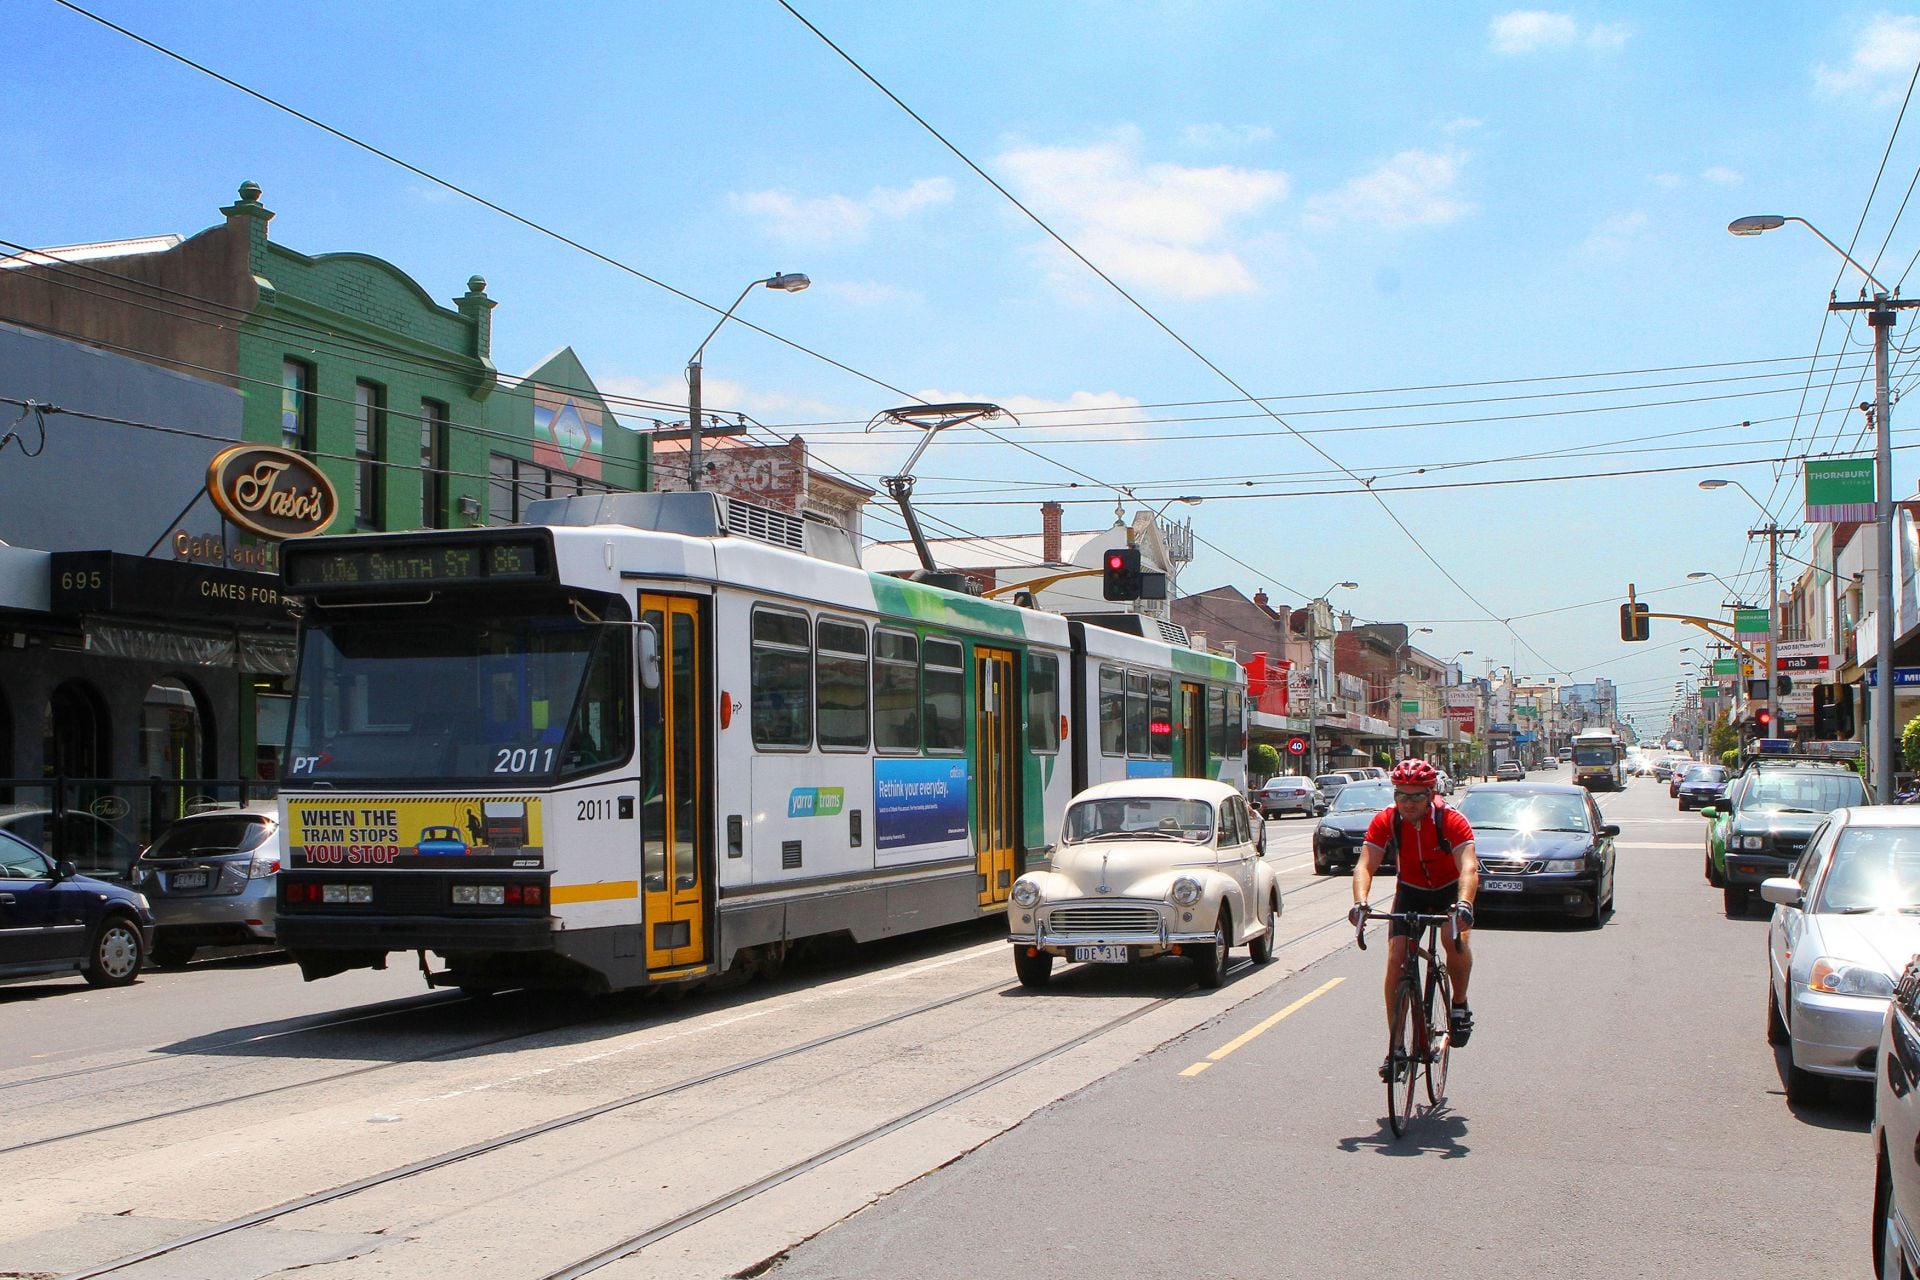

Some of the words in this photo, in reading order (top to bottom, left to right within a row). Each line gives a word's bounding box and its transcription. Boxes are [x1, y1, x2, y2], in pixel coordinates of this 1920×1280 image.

[1808, 470, 1871, 479] THORNBURY
[235, 460, 322, 522] Taso's
[62, 571, 101, 590] 695
[201, 580, 246, 601] CAKES
[251, 587, 277, 605] FOR
[1788, 658, 1807, 667] nab
[1291, 742, 1303, 750] 40
[293, 756, 318, 774] PT
[494, 748, 553, 773] 2011
[879, 780, 904, 798] Rethink
[904, 783, 919, 801] your
[919, 780, 949, 799] everyday.
[576, 800, 612, 821] 2011
[791, 794, 813, 814] yarra
[818, 793, 841, 809] trams
[301, 809, 356, 827] WHEN
[361, 809, 398, 826] THE
[302, 828, 344, 843] TRAM
[349, 827, 399, 843] STOPS
[303, 845, 344, 864] YOU
[347, 844, 400, 864] STOP
[1076, 947, 1097, 962] UDE
[1105, 946, 1127, 961] 314
